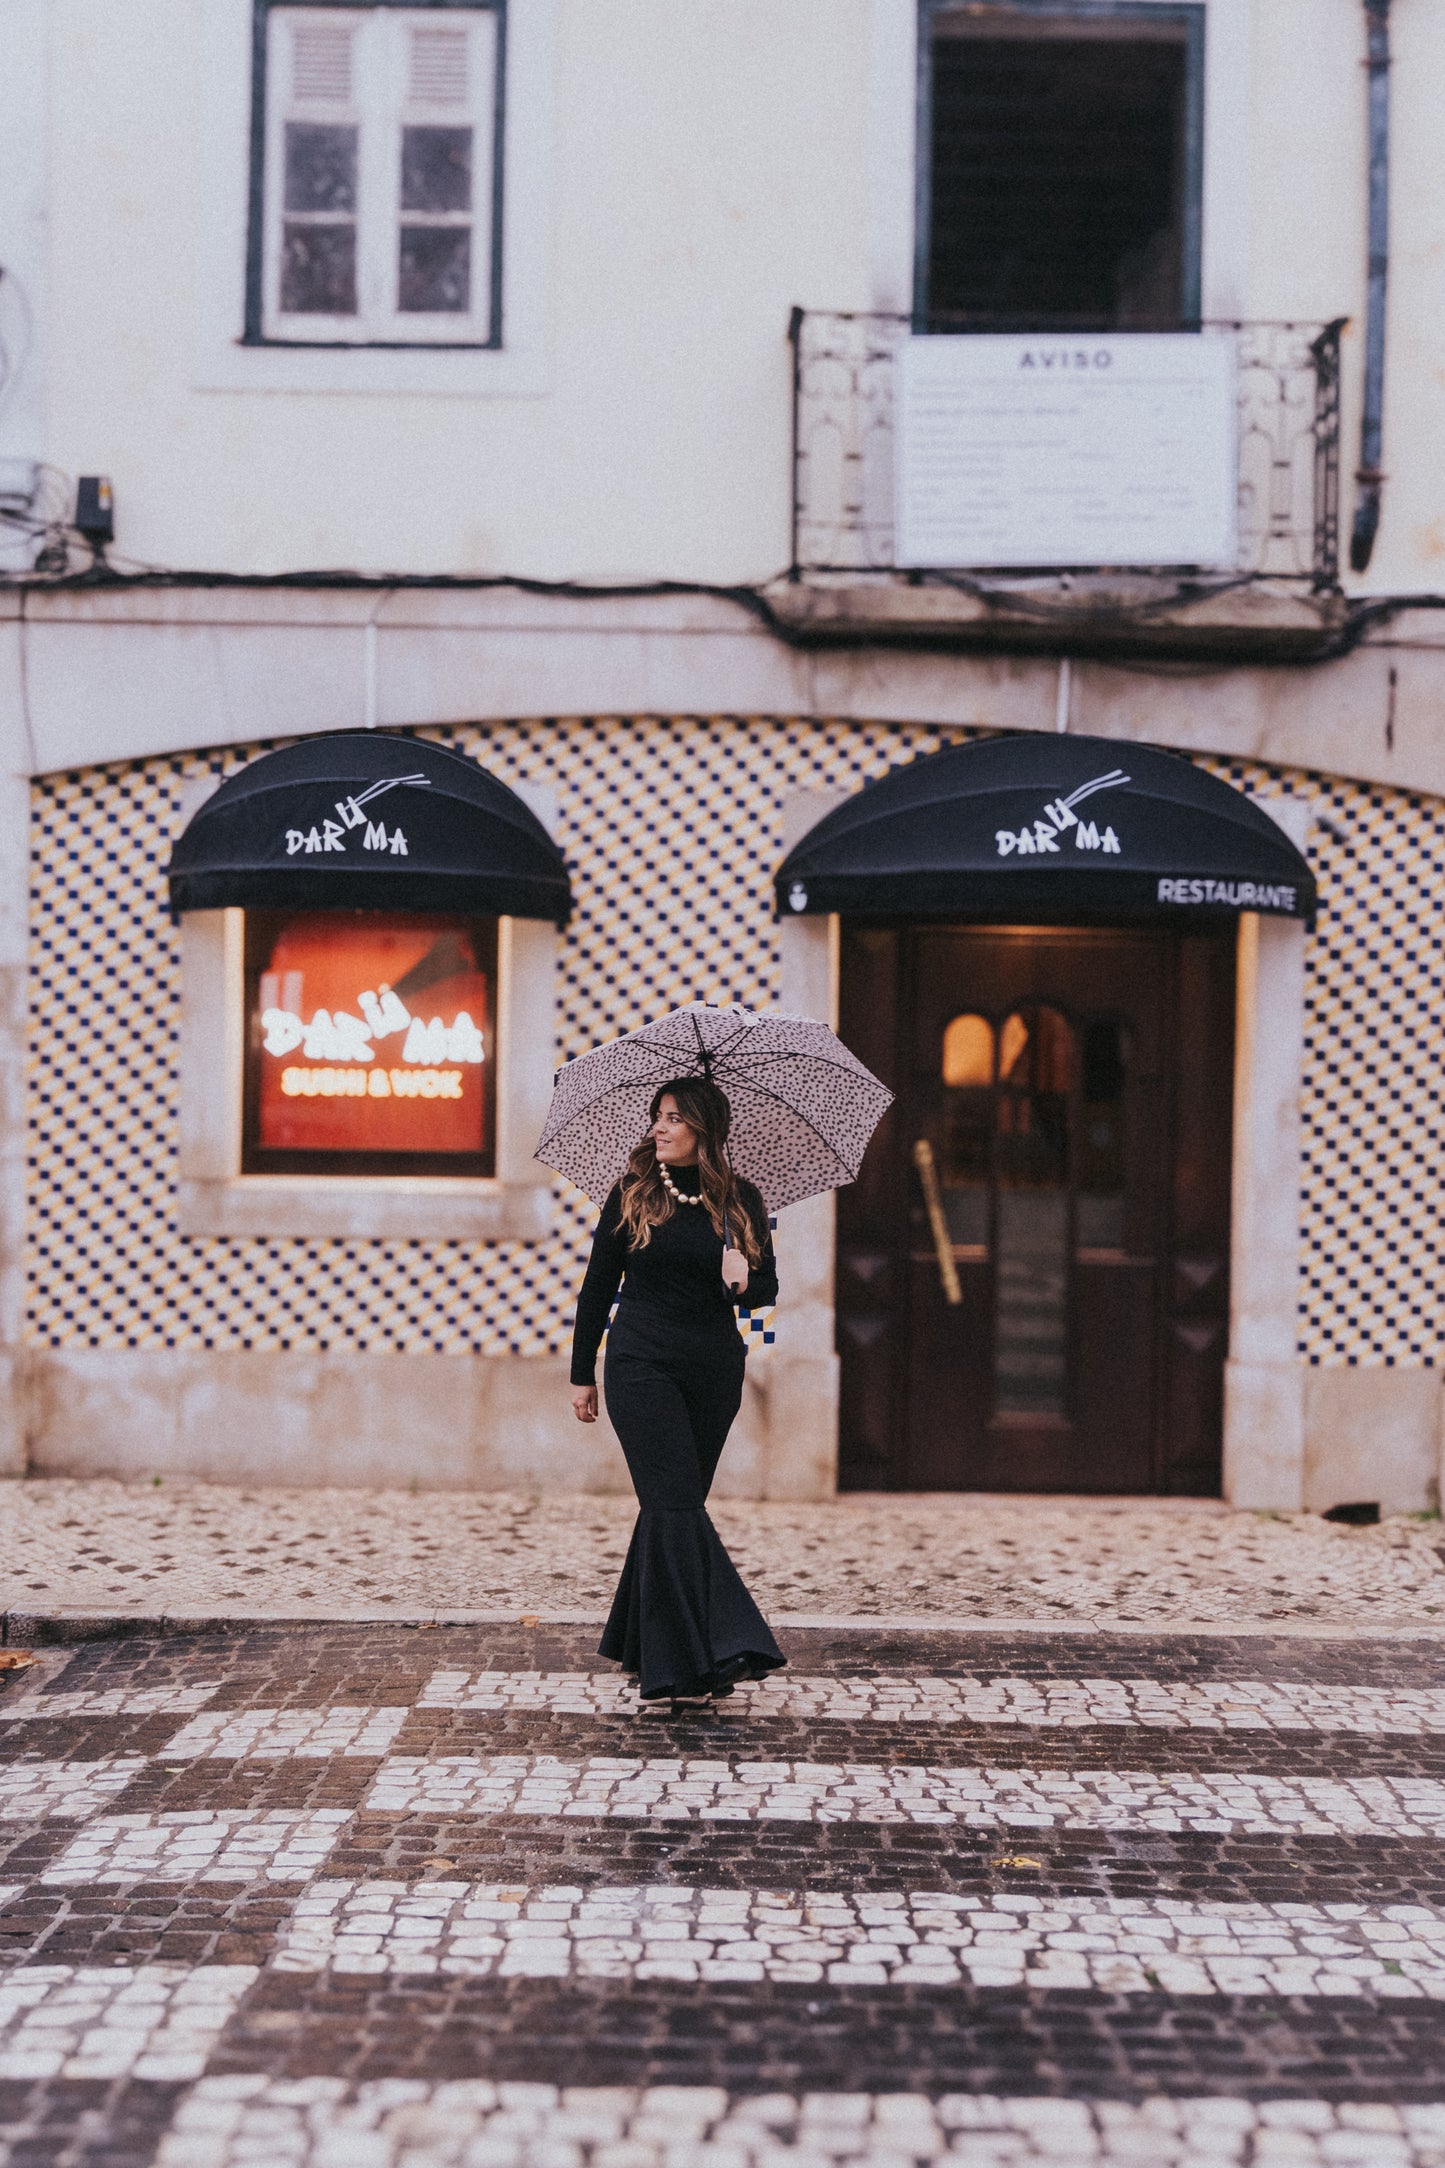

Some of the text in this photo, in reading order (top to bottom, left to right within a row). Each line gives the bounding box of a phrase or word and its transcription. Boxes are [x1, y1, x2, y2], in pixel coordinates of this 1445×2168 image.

[1021, 350, 1112, 369] AVISO
[286, 796, 408, 855] DARUMA
[996, 798, 1121, 855] DARUMA
[1158, 878, 1297, 910] RESTAURANTE
[261, 989, 485, 1064] DARUMA
[392, 1069, 463, 1099] WOK
